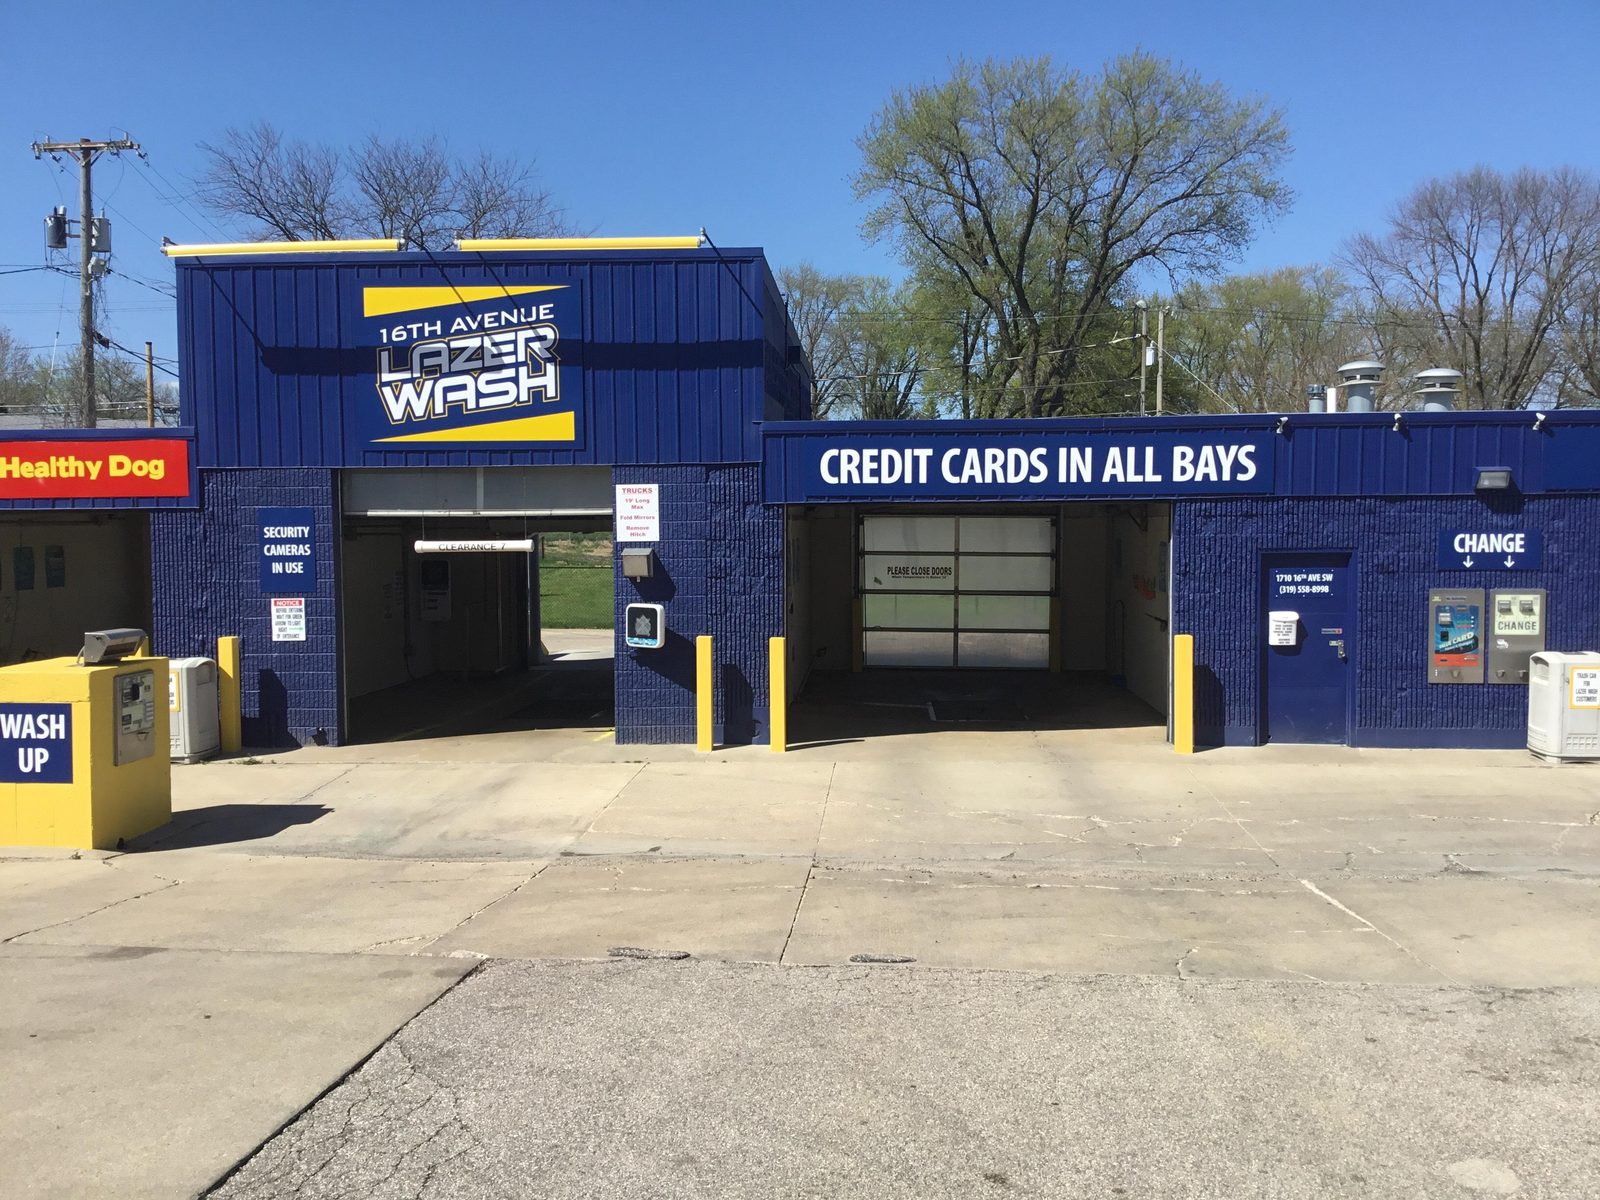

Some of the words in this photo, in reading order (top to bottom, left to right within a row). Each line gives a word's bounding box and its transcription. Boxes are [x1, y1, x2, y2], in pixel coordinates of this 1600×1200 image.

[379, 320, 442, 343] 16TH
[450, 303, 554, 334] AVENUE
[379, 325, 556, 383] LAZER
[379, 362, 557, 421] WASH
[0, 455, 102, 480] Healthy
[108, 454, 165, 480] Dog
[819, 448, 934, 485] CREDIT
[941, 447, 1049, 484] CARDS
[1058, 446, 1093, 483] IN
[1101, 445, 1162, 483] ALL
[1172, 444, 1257, 482] BAYS
[263, 526, 310, 538] SECURITY
[263, 544, 311, 556] CAMERAS
[438, 543, 497, 552] CLEARANCE
[1453, 533, 1525, 553] CHANGE
[272, 562, 283, 574] IN
[285, 562, 304, 574] USE
[887, 566, 910, 576] PLEASE
[911, 566, 931, 576] CLOSE
[931, 566, 953, 576] DOORS
[1275, 574, 1292, 582] 1710
[1307, 573, 1321, 582] AVE
[1321, 573, 1334, 582] SW
[1279, 585, 1297, 595] (319)
[1297, 585, 1330, 594] 558-8998
[1497, 621, 1537, 631] CHANGE
[0, 713, 66, 740] WASH
[18, 747, 50, 773] UP
